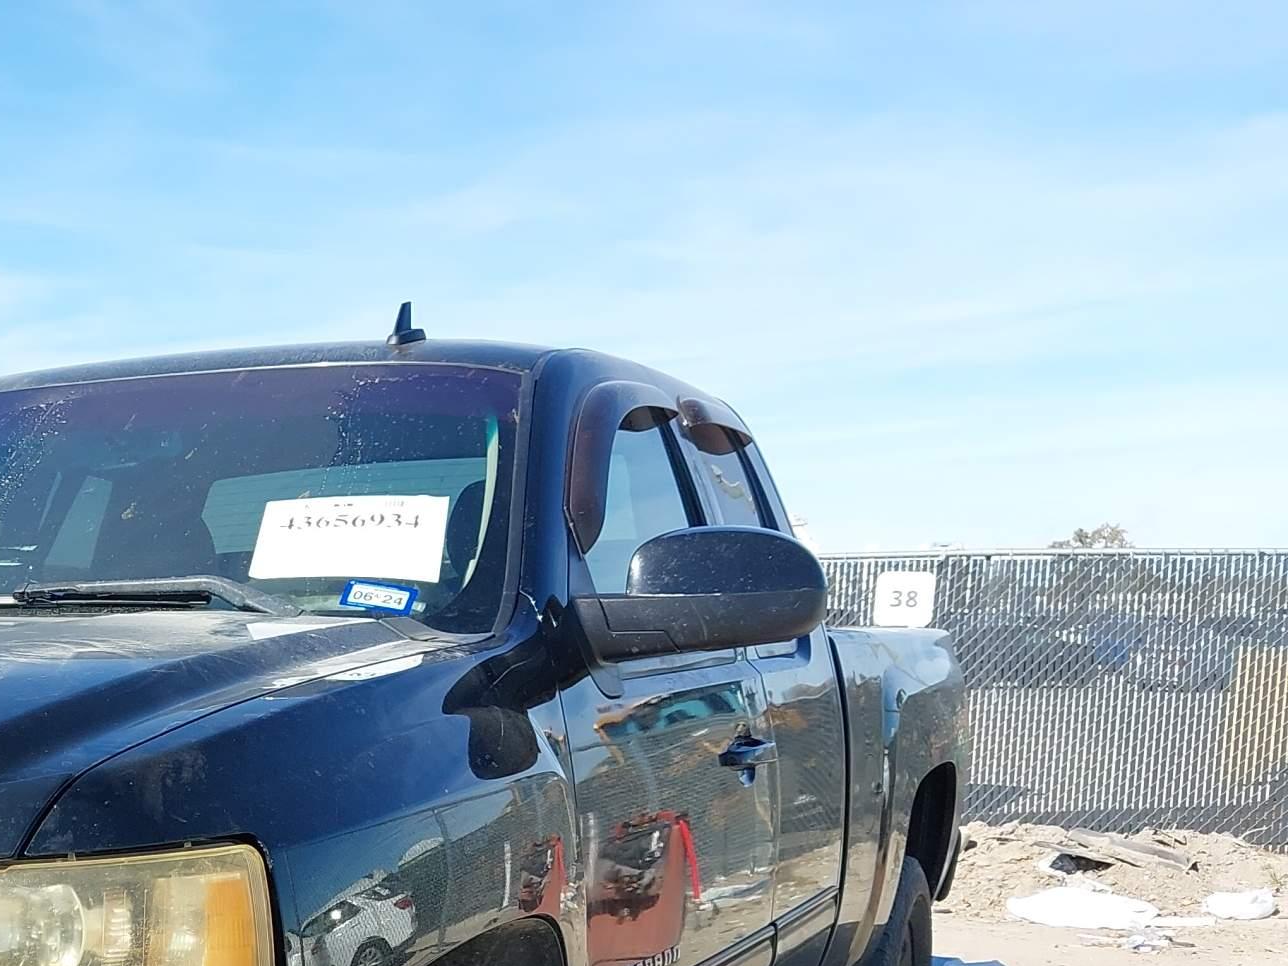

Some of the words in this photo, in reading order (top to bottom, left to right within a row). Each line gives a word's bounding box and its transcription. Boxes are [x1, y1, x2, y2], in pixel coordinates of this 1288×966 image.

[279, 513, 420, 531] 43656934
[352, 589, 373, 601] 06
[383, 594, 404, 606] 24
[890, 590, 918, 607] 38
